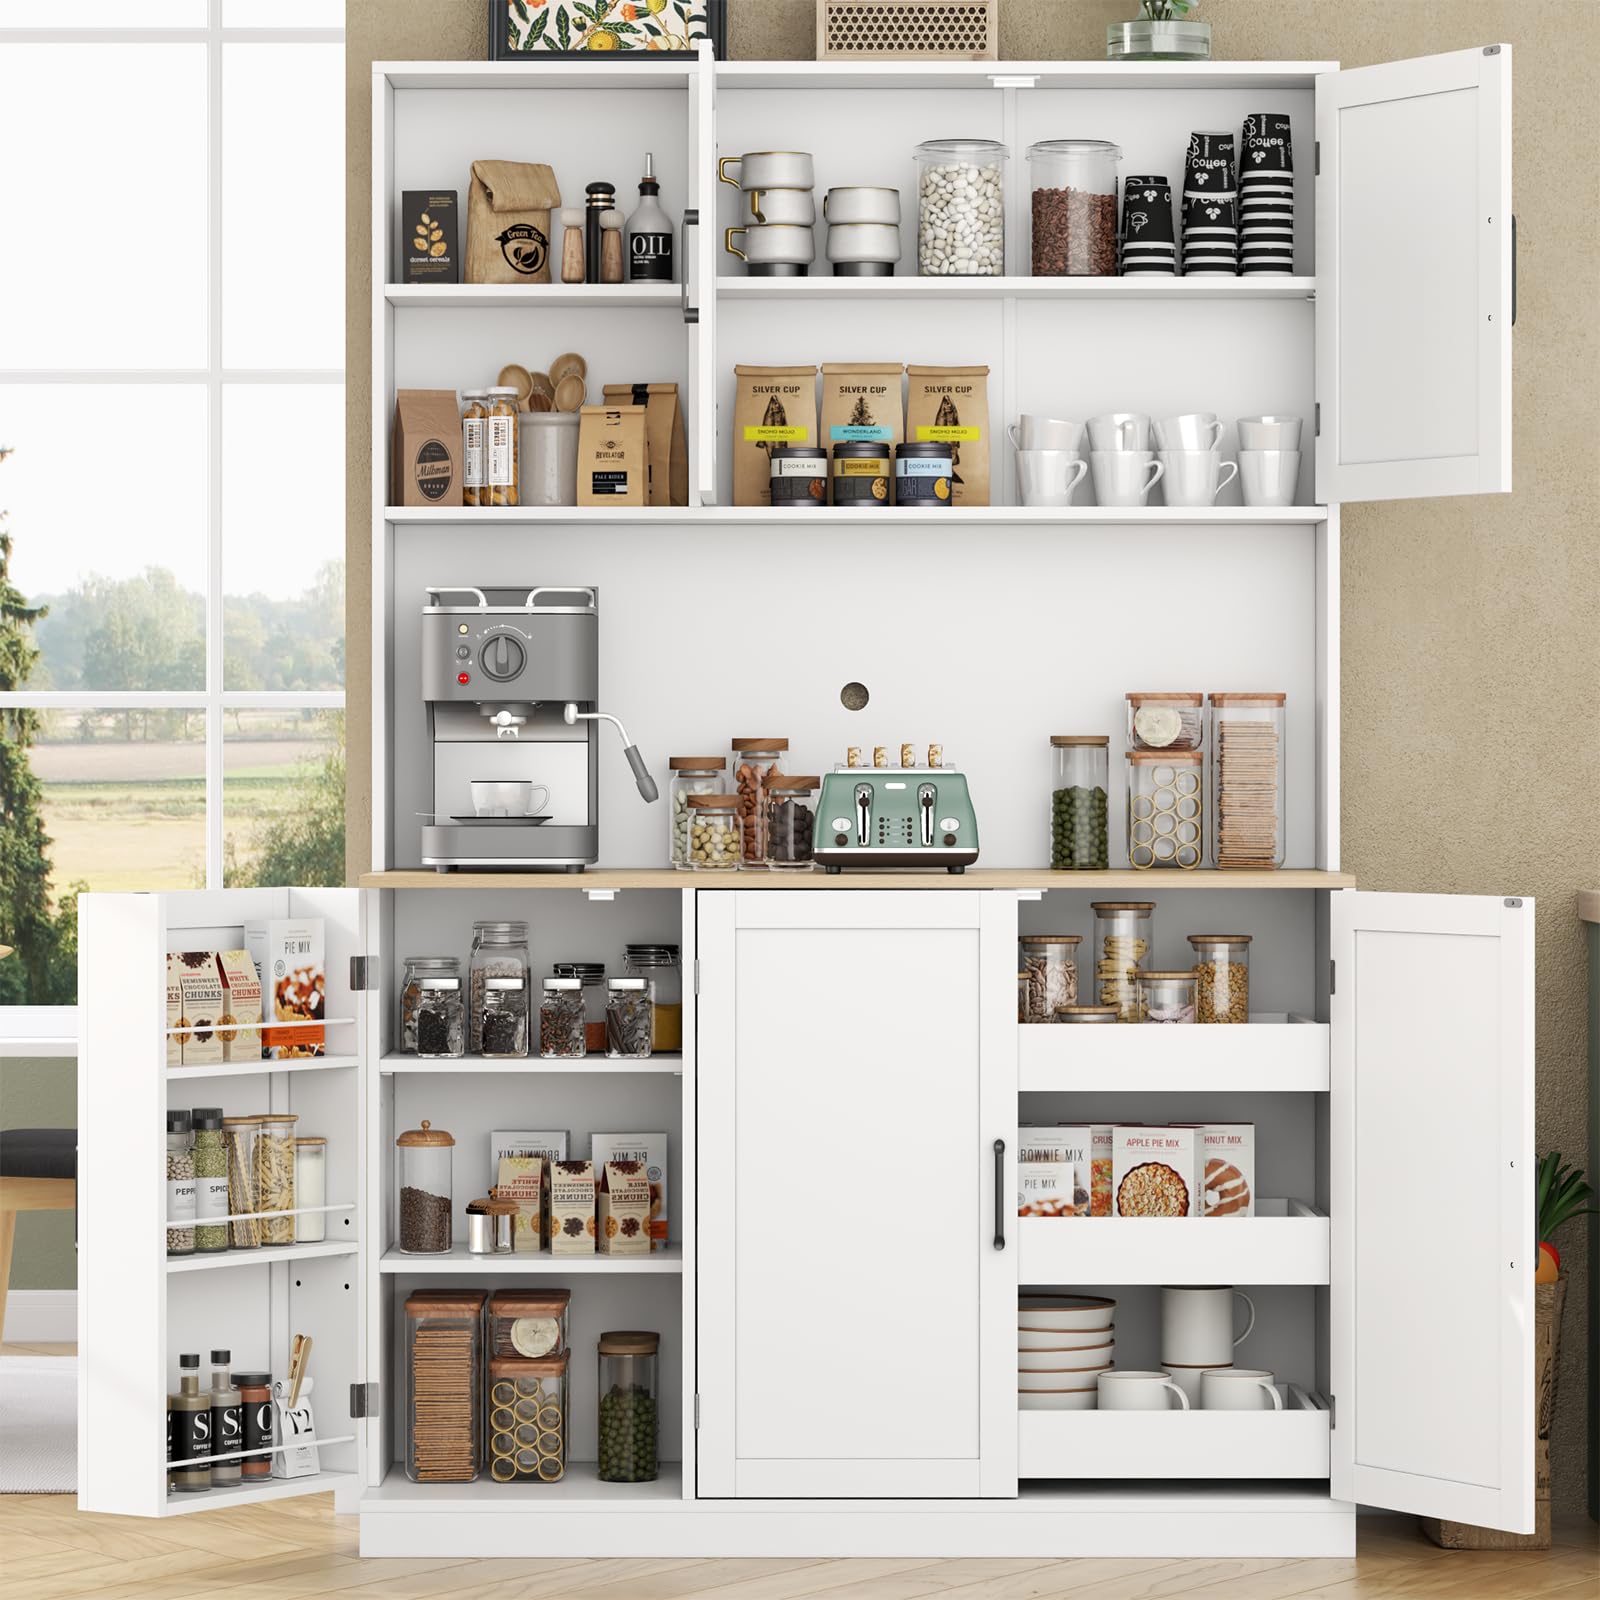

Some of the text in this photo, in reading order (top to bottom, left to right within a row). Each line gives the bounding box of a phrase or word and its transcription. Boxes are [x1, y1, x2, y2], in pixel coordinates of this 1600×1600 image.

[507, 230, 528, 240] Green
[632, 235, 671, 256] OIL
[752, 385, 801, 393] SILVER CUP
[839, 386, 887, 394] SILVER CUP
[924, 385, 972, 393] SILVER CUP
[284, 941, 311, 954] PIE MIX
[184, 990, 222, 999] CHUNKS
[231, 988, 261, 997] CHUNKS
[1127, 1138, 1180, 1148] APPLE PIE MIX
[1227, 1135, 1242, 1145] MIX
[1018, 1148, 1084, 1162] ROWNIE MIX
[1024, 1179, 1057, 1189] PIE MIX
